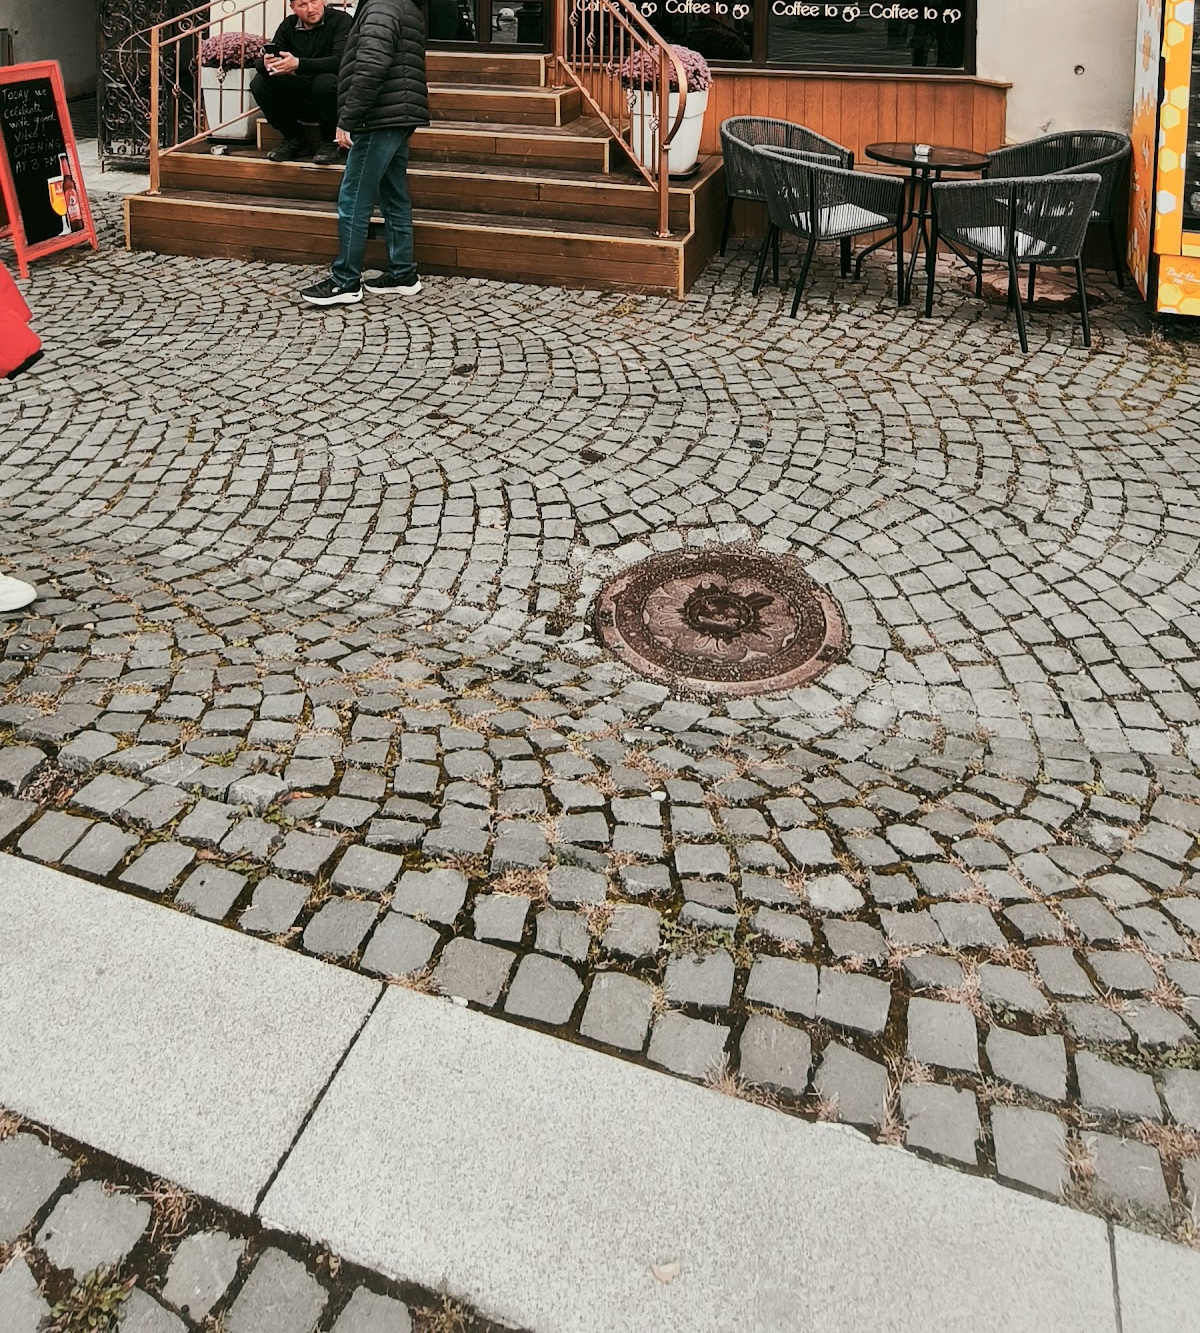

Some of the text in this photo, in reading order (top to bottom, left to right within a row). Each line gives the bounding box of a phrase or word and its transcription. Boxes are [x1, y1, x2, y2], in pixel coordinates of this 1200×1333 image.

[772, 0, 820, 16] Coffee
[869, 2, 919, 19] Coffee
[30, 158, 40, 170] 3
